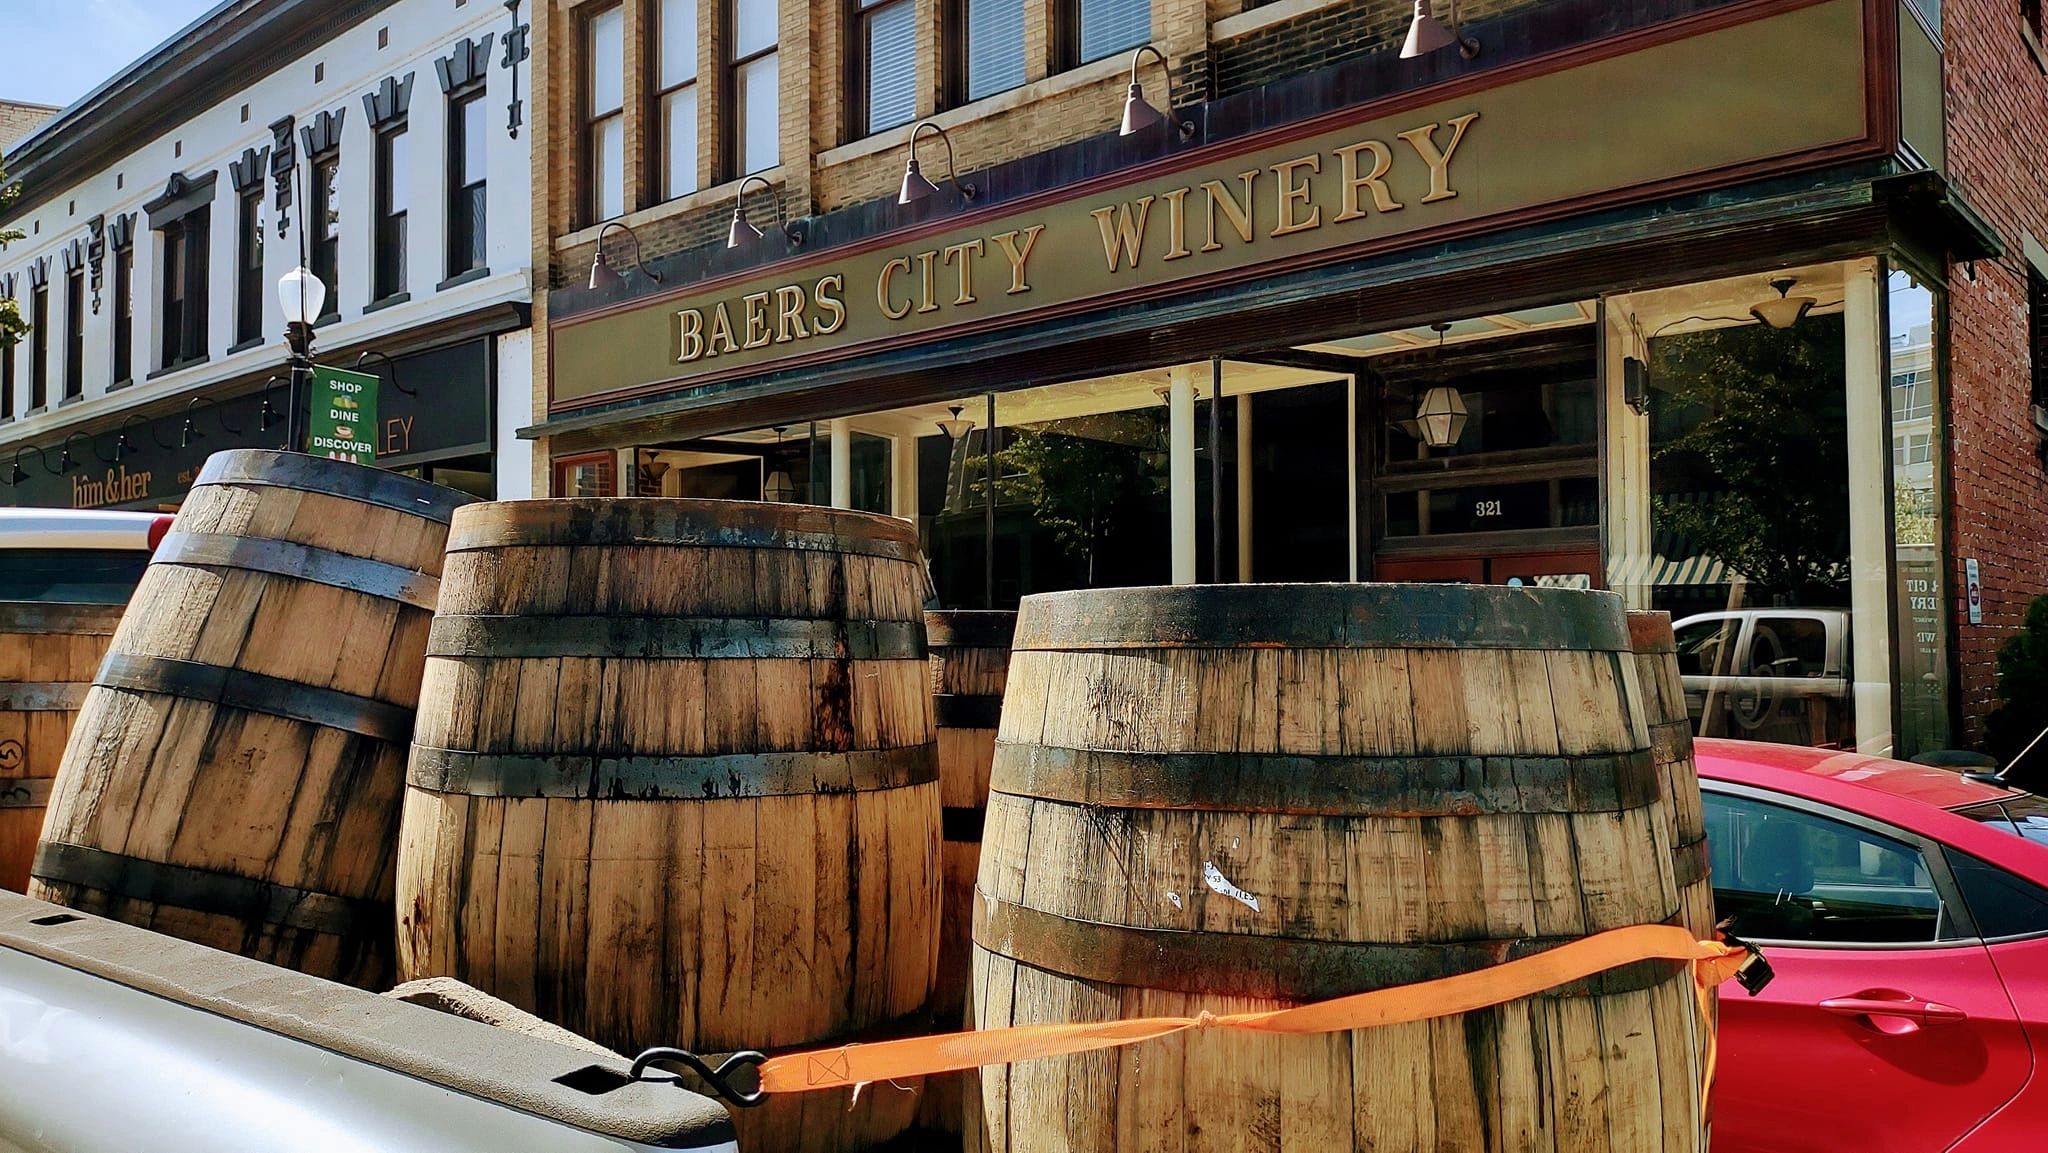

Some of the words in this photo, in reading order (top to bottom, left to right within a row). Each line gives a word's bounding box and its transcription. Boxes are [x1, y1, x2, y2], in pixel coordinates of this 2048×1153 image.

[676, 272, 847, 363] BAERS
[877, 222, 1046, 320] CITY
[1089, 111, 1481, 274] WINERY
[329, 379, 362, 394] SHOP
[330, 409, 359, 422] DINE
[313, 436, 372, 453] DISCOVER
[1475, 500, 1503, 517] 321
